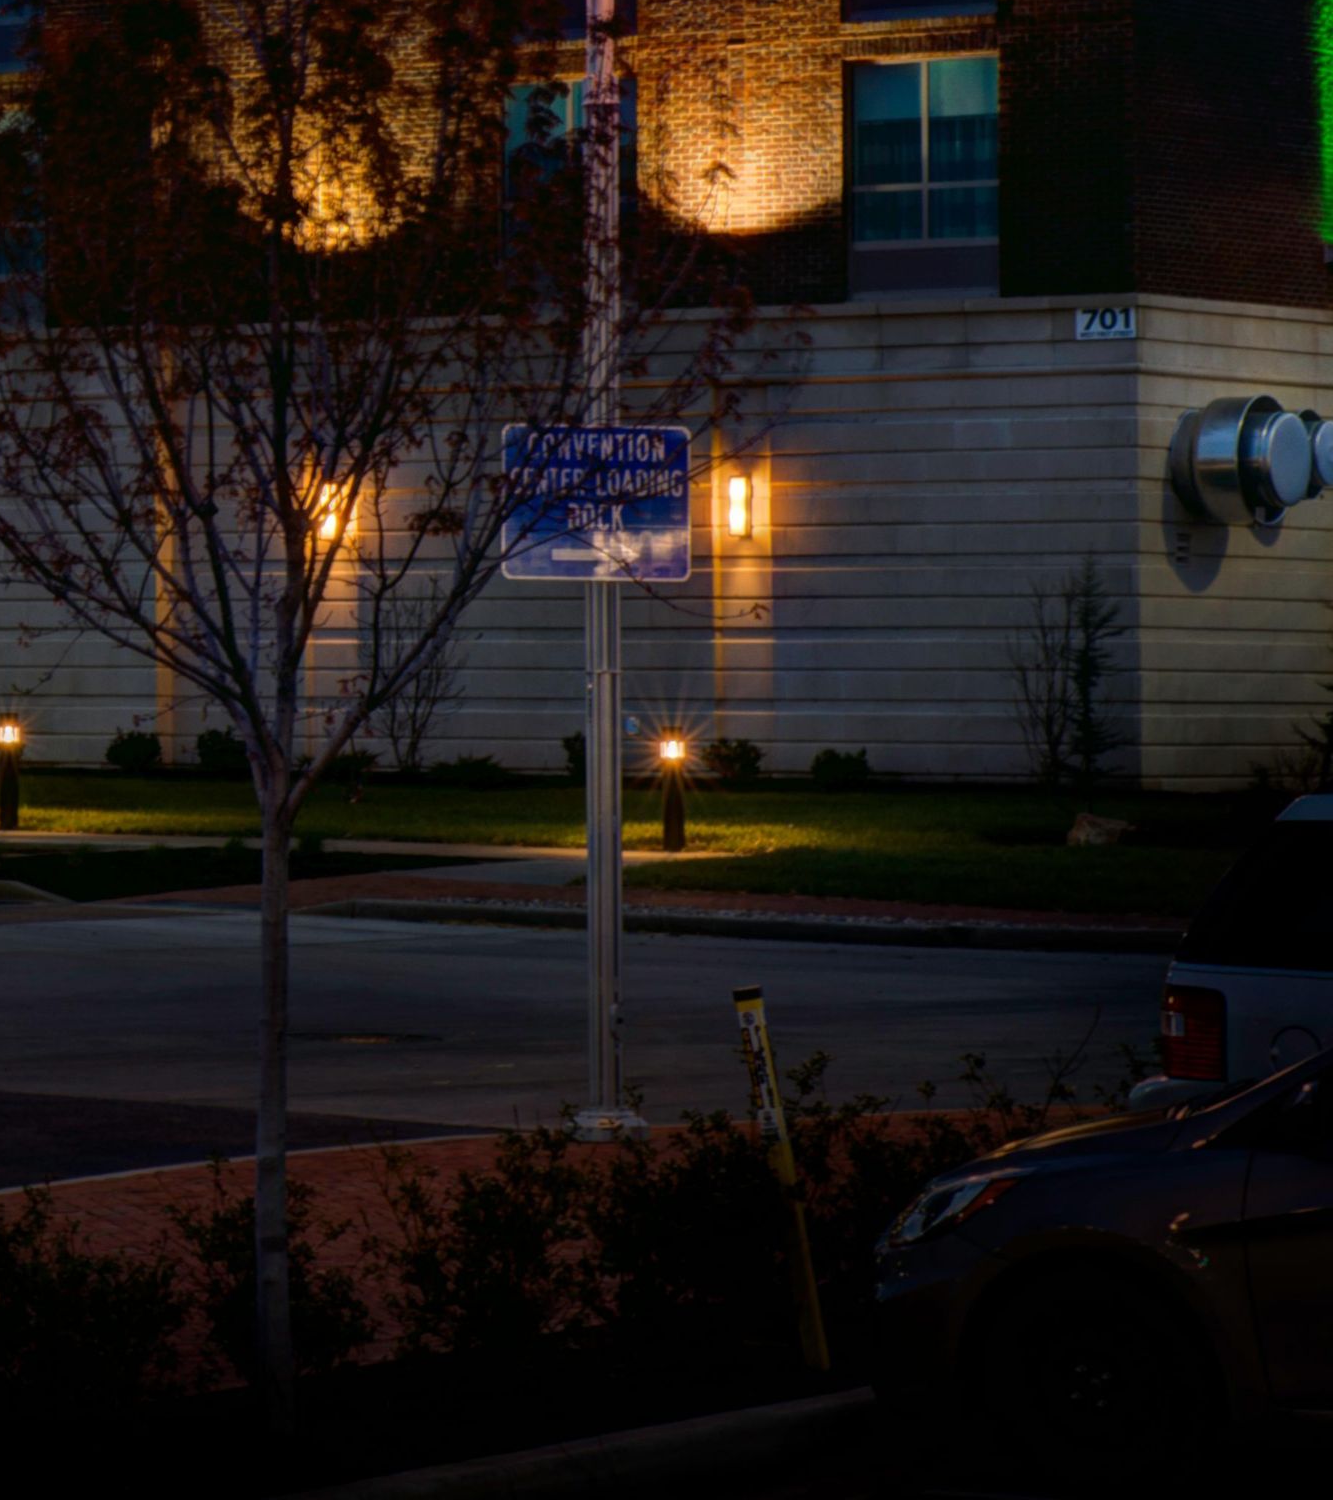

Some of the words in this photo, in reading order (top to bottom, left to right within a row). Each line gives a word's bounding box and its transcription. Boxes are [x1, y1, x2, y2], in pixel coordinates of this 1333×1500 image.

[1081, 308, 1131, 330] 701
[527, 432, 666, 462] CONVENTION
[595, 468, 685, 498] LOADING
